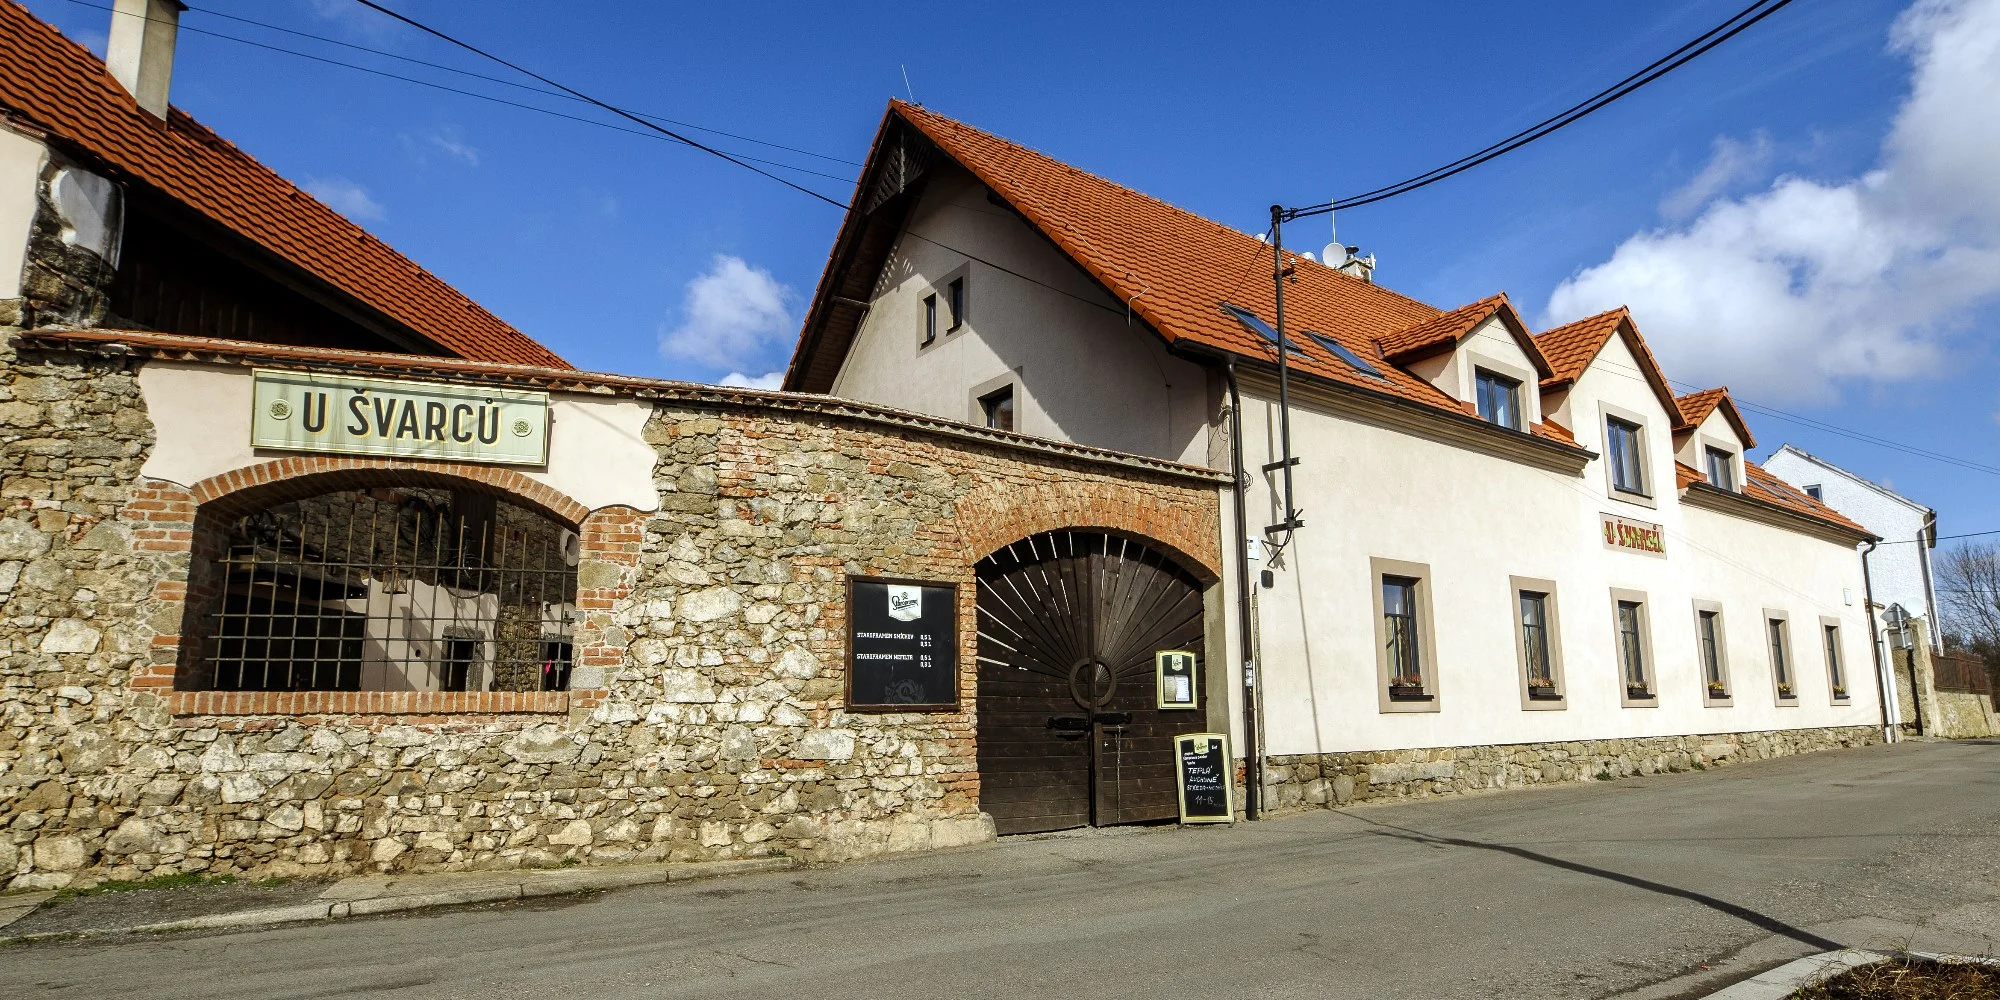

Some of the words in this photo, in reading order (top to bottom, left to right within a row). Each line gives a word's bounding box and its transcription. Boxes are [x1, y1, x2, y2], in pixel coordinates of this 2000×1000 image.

[303, 391, 328, 433] U
[347, 387, 500, 445] ŠVARCŮ
[1604, 520, 1614, 544] U
